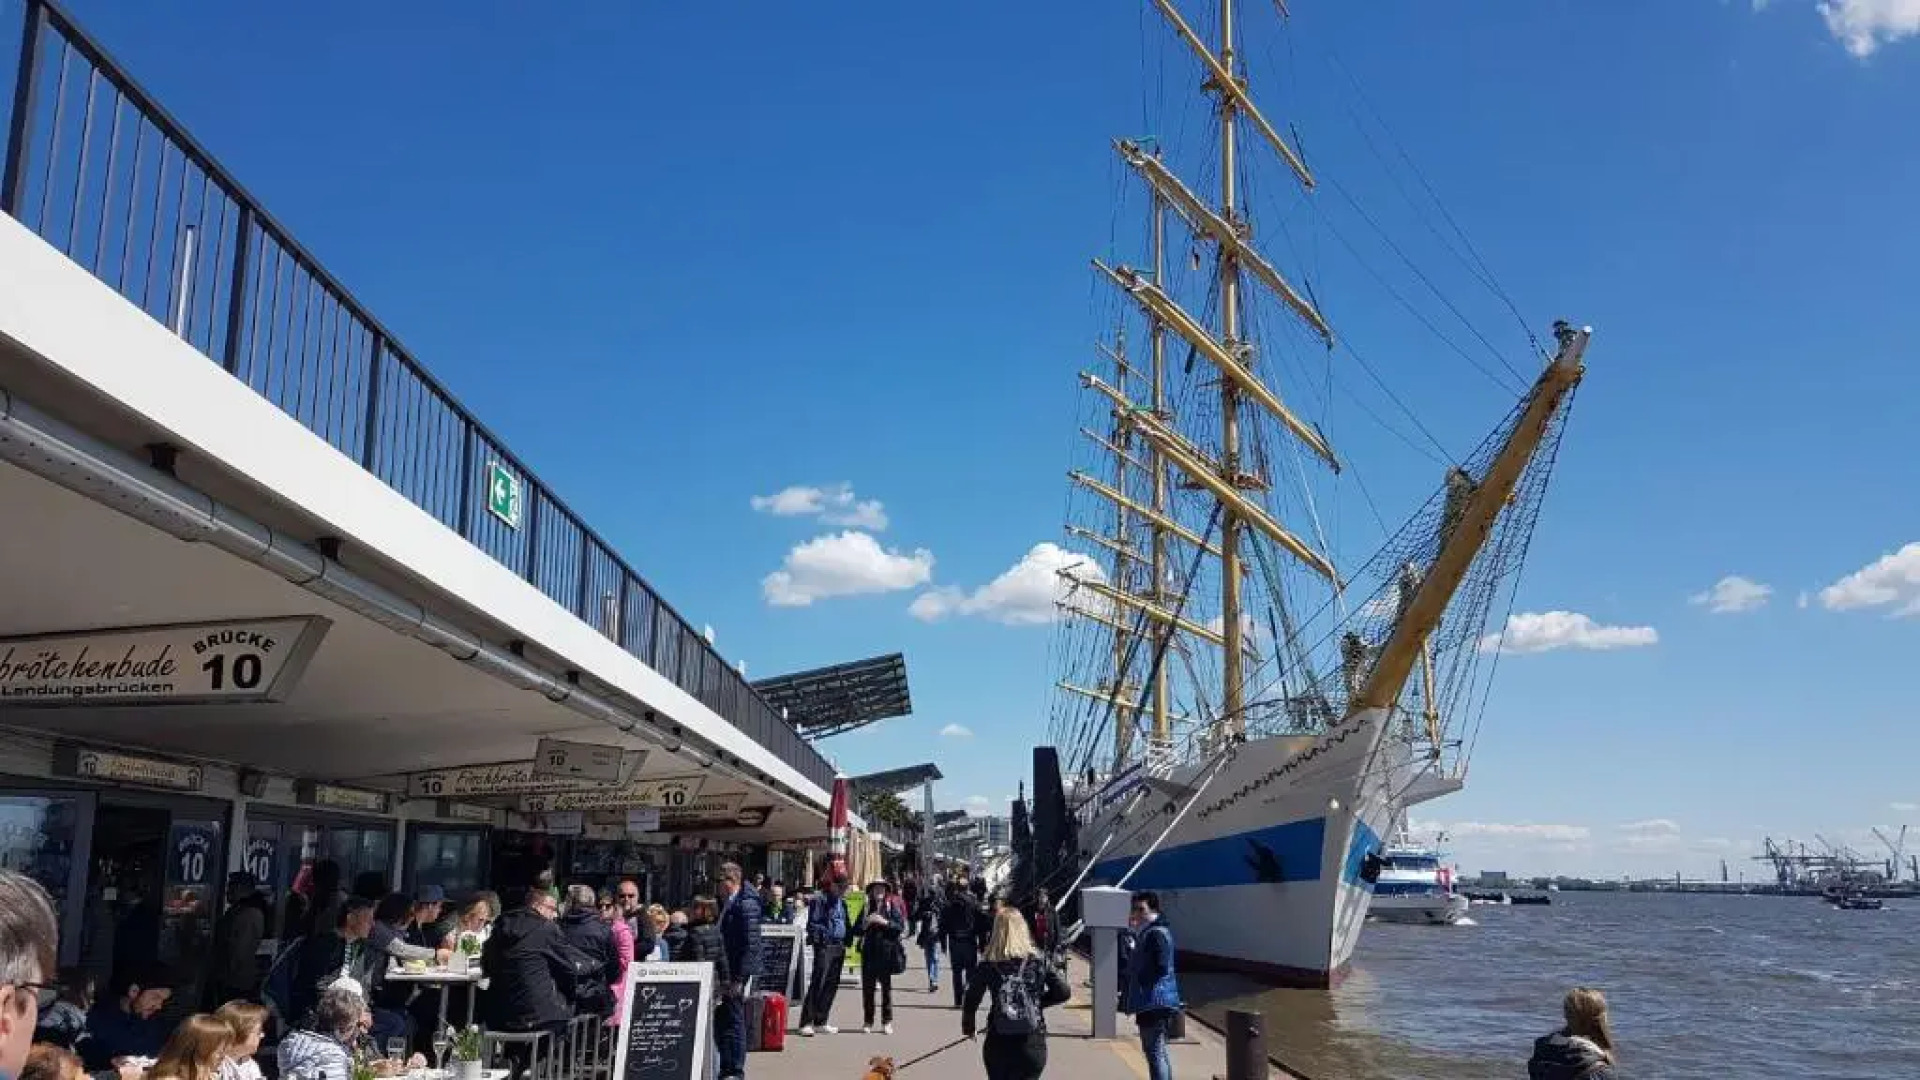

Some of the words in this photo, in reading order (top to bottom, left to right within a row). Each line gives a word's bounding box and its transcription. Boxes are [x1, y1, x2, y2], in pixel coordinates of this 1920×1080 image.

[192, 630, 277, 655] BRÜCKE
[202, 653, 262, 691] 10
[1, 682, 174, 697] Landungsbrücken
[550, 755, 565, 766] 10
[420, 781, 441, 794] 10
[661, 791, 685, 805] 10
[528, 801, 544, 810] 10
[182, 852, 204, 881] 10
